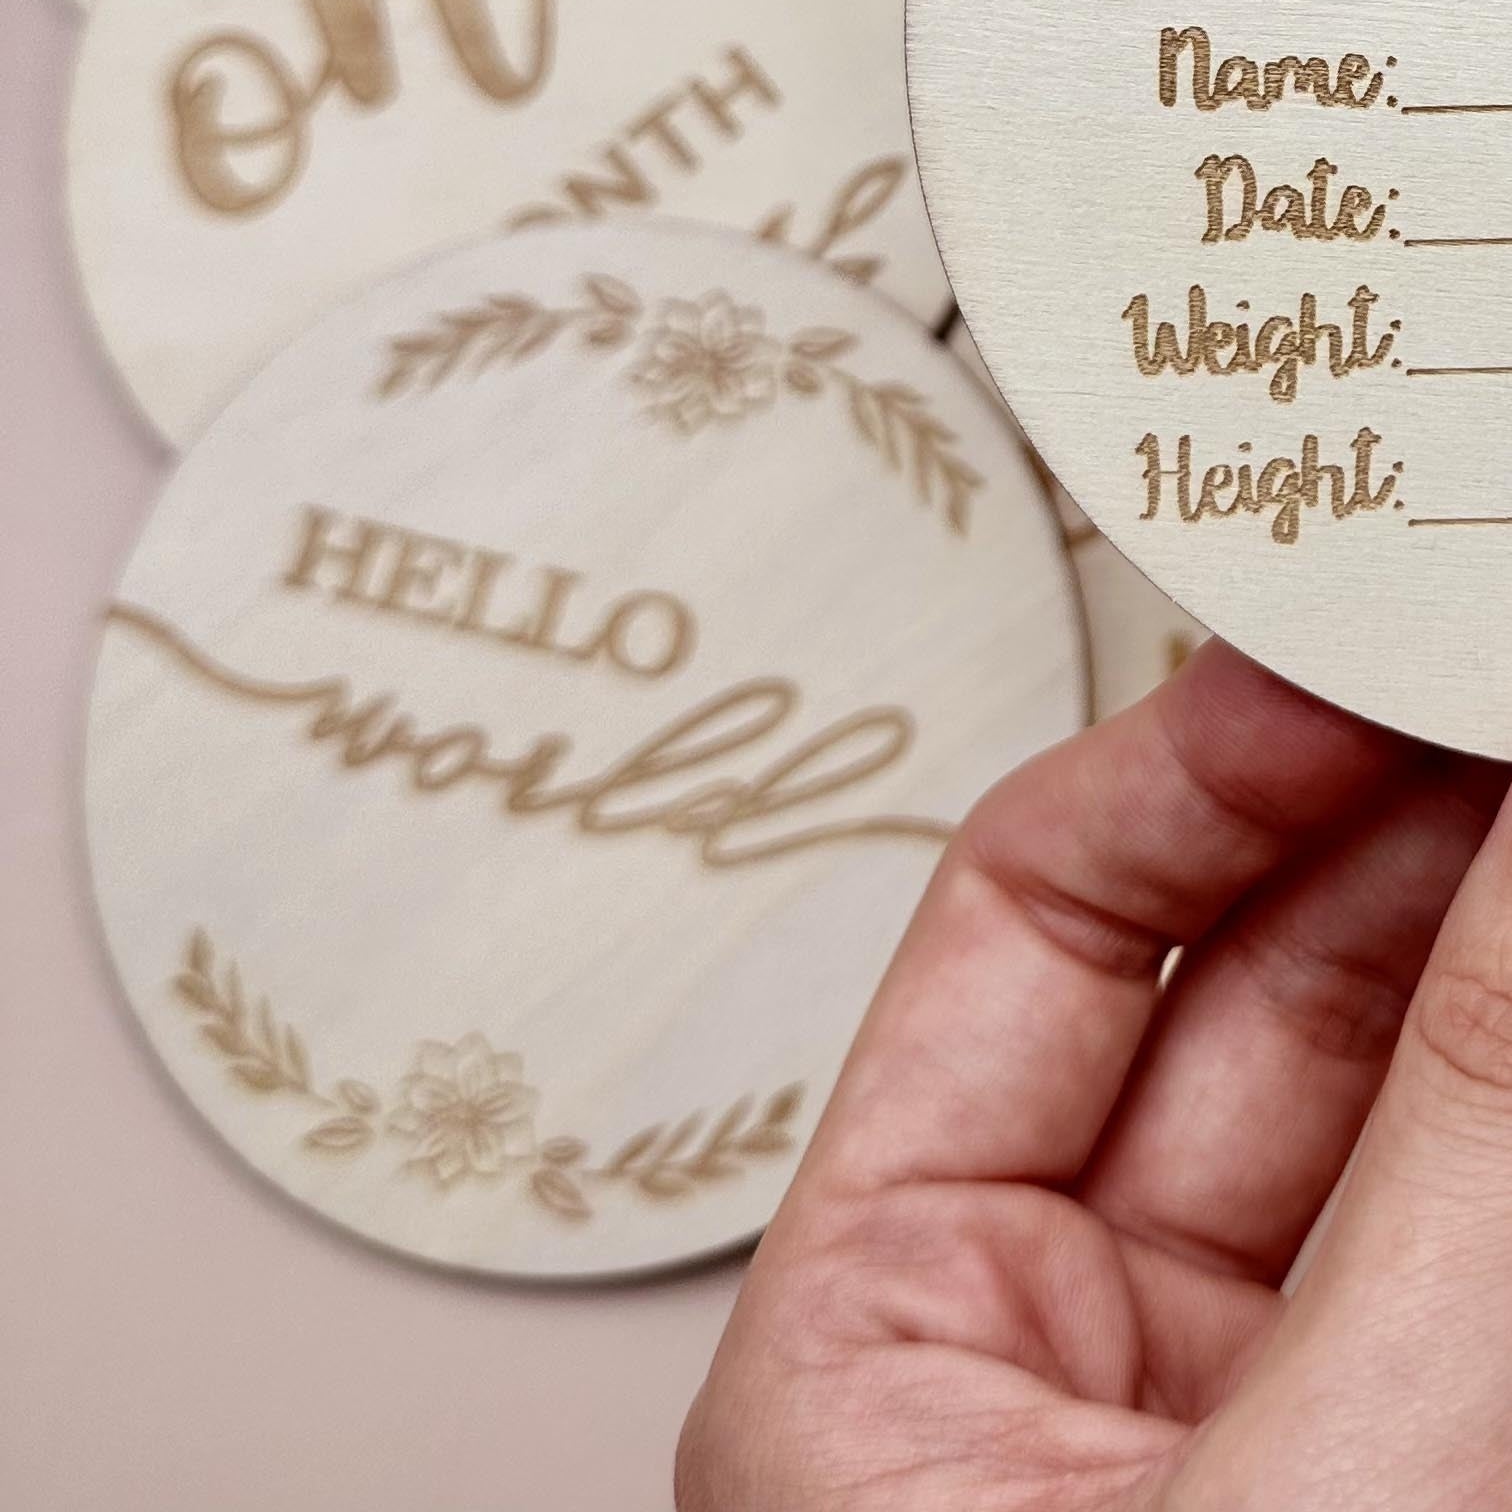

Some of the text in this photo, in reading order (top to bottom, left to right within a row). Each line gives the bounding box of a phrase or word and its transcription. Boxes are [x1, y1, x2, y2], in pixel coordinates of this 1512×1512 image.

[1157, 24, 1399, 113] Name:
[500, 42, 786, 230] NTH
[1194, 152, 1402, 246] Date:
[1120, 282, 1404, 404] Weight:
[1132, 425, 1406, 546] Height:
[280, 504, 698, 680] HELLO
[230, 676, 960, 870] world
